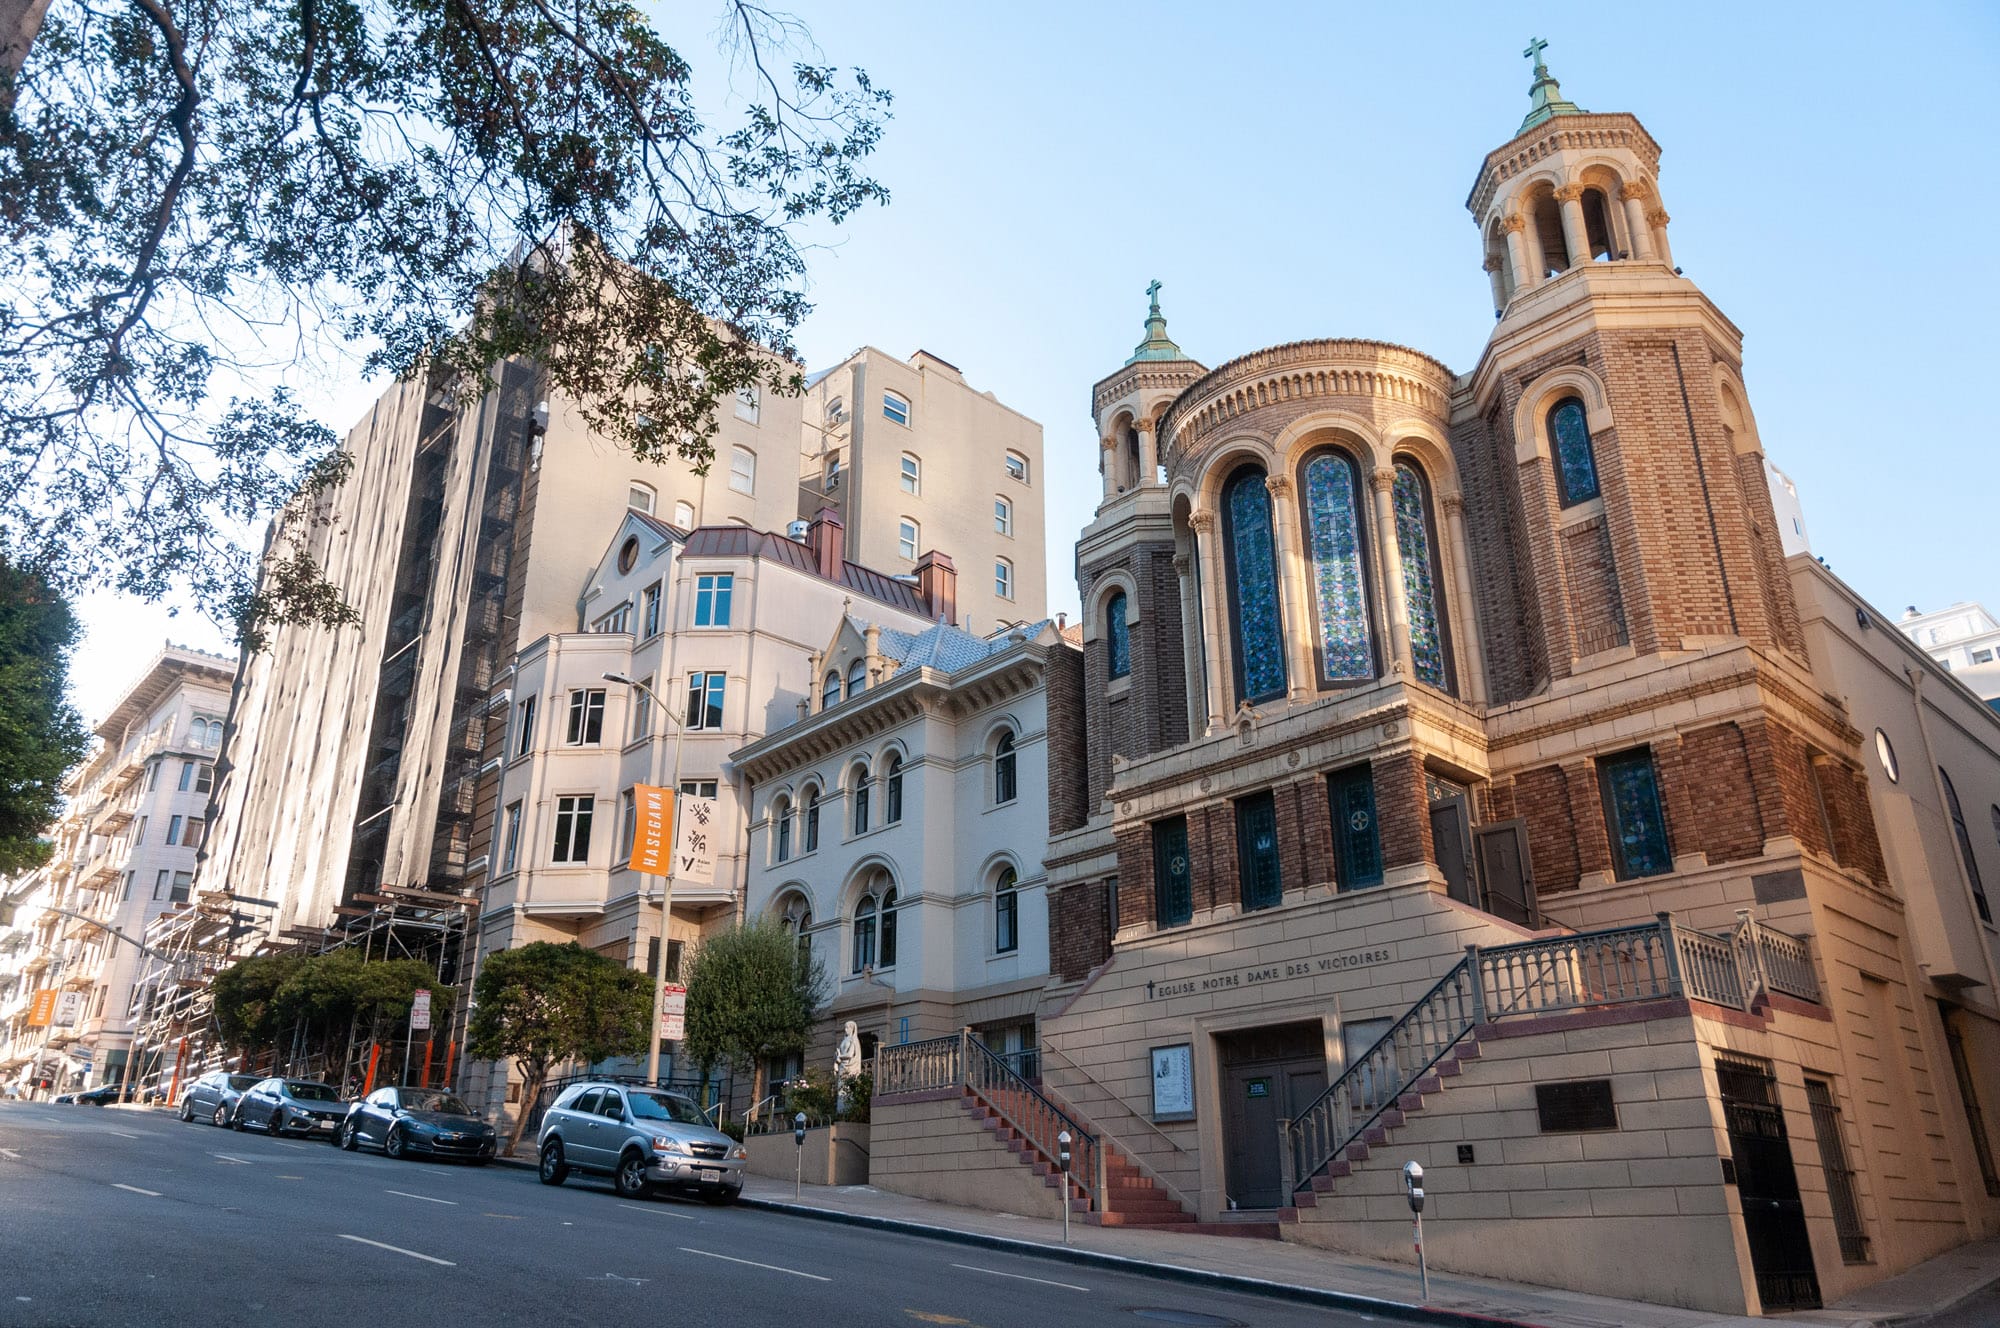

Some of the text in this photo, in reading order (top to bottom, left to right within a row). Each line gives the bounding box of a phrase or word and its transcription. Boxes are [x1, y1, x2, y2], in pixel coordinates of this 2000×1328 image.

[643, 793, 662, 867] HASEGAWA
[1159, 950, 1390, 997] EGLISE NOTRE DAME DES VICTOIRES
